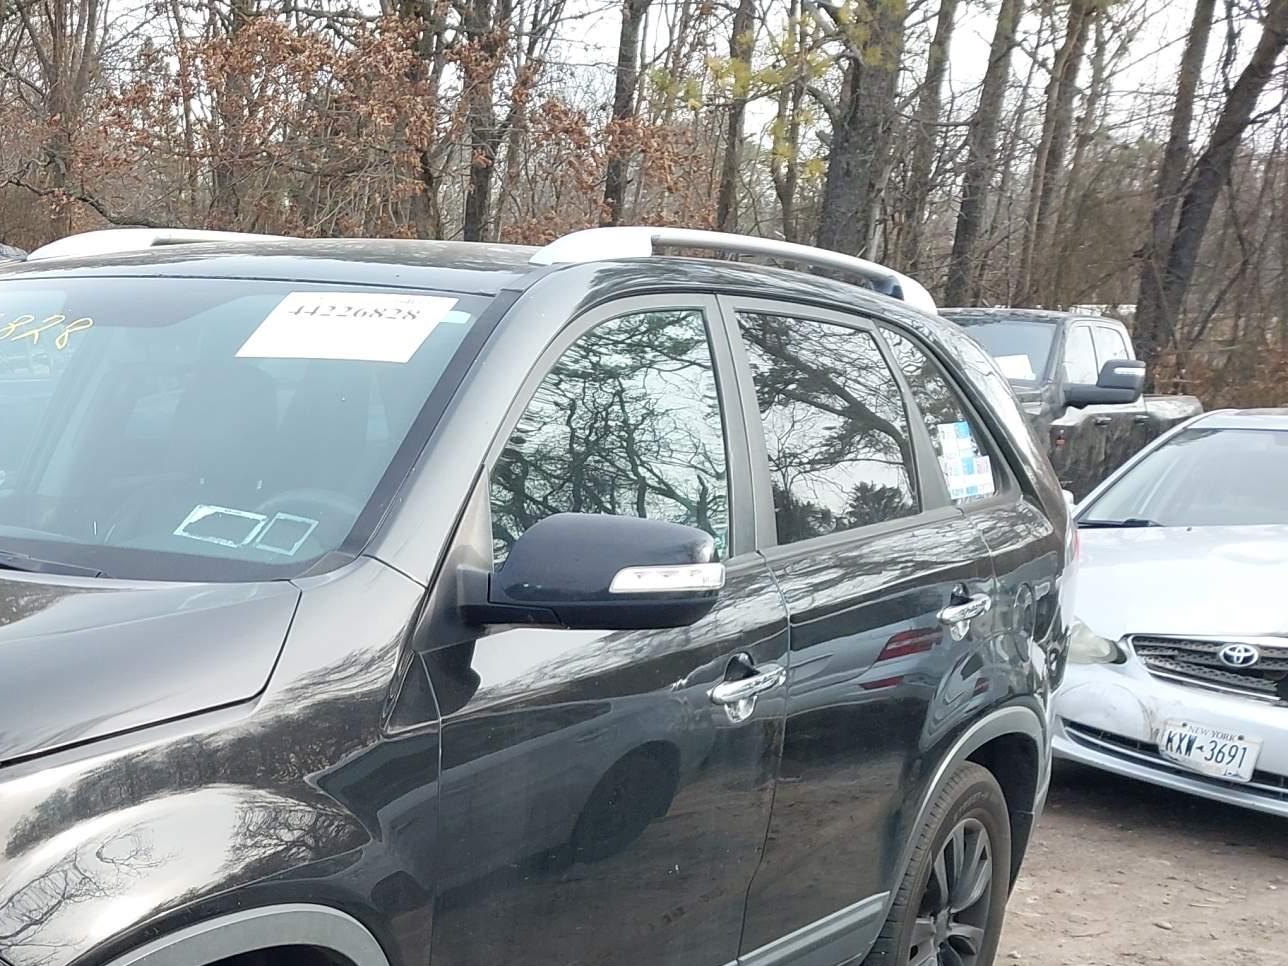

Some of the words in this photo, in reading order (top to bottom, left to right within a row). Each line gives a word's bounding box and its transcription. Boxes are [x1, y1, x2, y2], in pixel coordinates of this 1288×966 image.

[287, 304, 421, 321] 44226828
[1188, 725, 1209, 736] NEW
[1211, 729, 1236, 742] YORK
